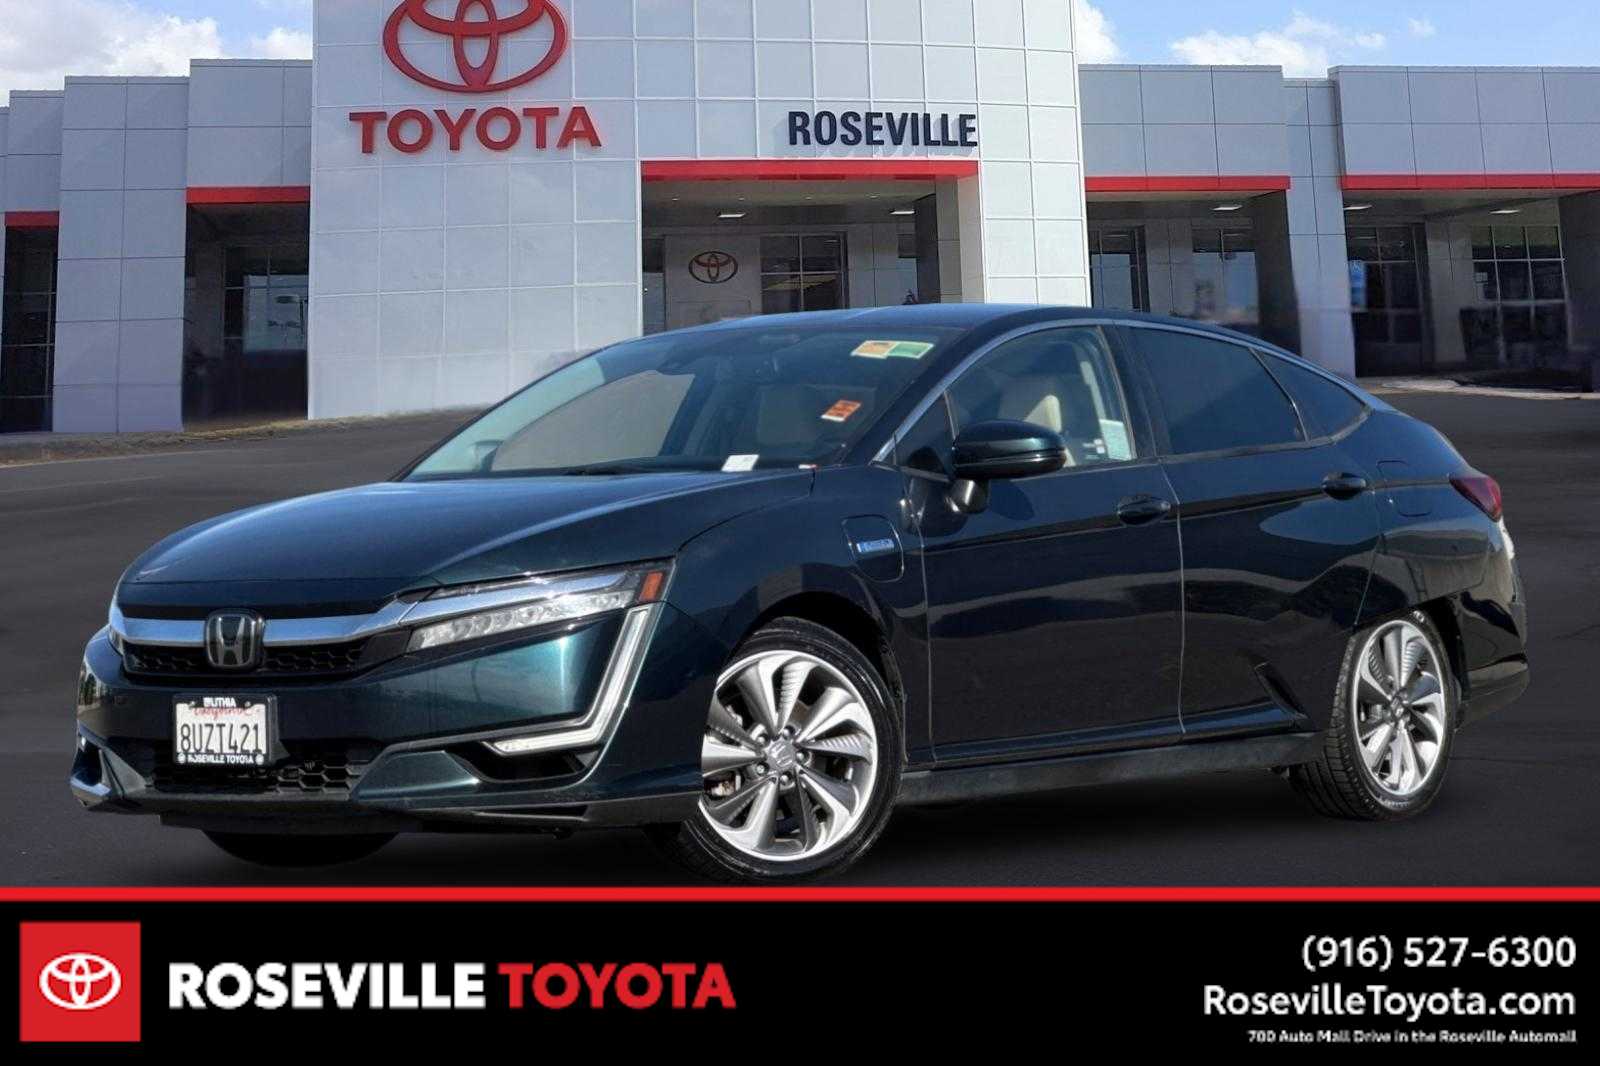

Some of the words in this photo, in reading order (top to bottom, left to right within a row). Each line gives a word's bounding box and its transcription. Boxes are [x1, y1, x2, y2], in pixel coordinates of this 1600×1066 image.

[350, 106, 602, 154] TOYOTA
[788, 110, 978, 148] ROSEVILLE
[180, 723, 262, 753] 8UZT421
[226, 754, 254, 764] TOYOTA
